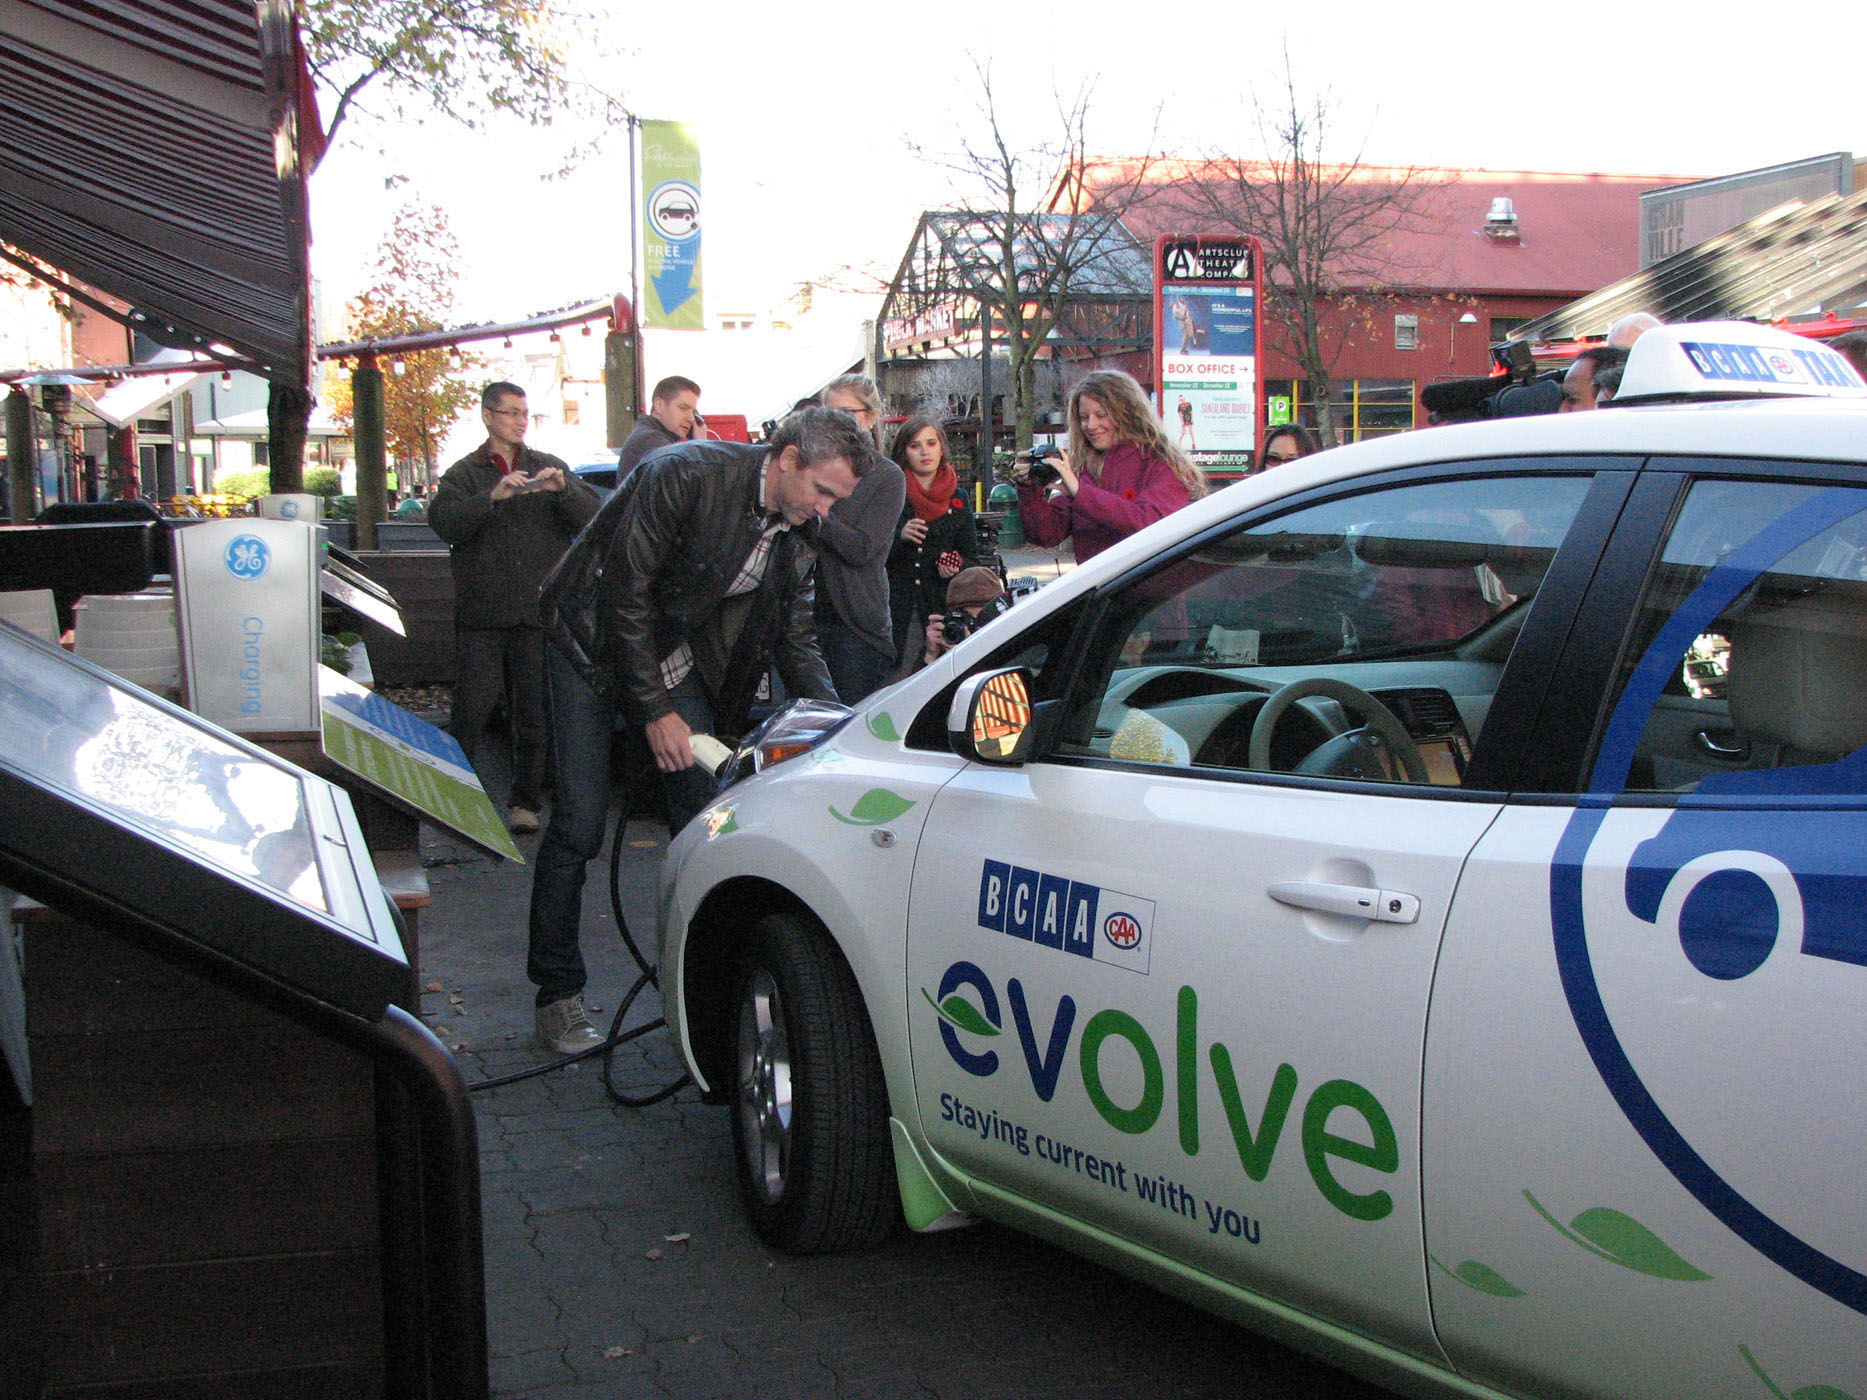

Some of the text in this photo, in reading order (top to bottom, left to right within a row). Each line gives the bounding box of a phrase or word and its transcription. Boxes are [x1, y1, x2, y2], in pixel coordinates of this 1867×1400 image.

[648, 245, 680, 257] FREE
[1168, 363, 1236, 374] BOX OFFICE
[1689, 350, 1770, 375] BCAA
[240, 616, 266, 713] Charging
[985, 874, 1088, 944] BCAA
[1108, 917, 1136, 946] CAA
[934, 960, 1400, 1222] evolve
[940, 1092, 1261, 1245] Staying current with you
